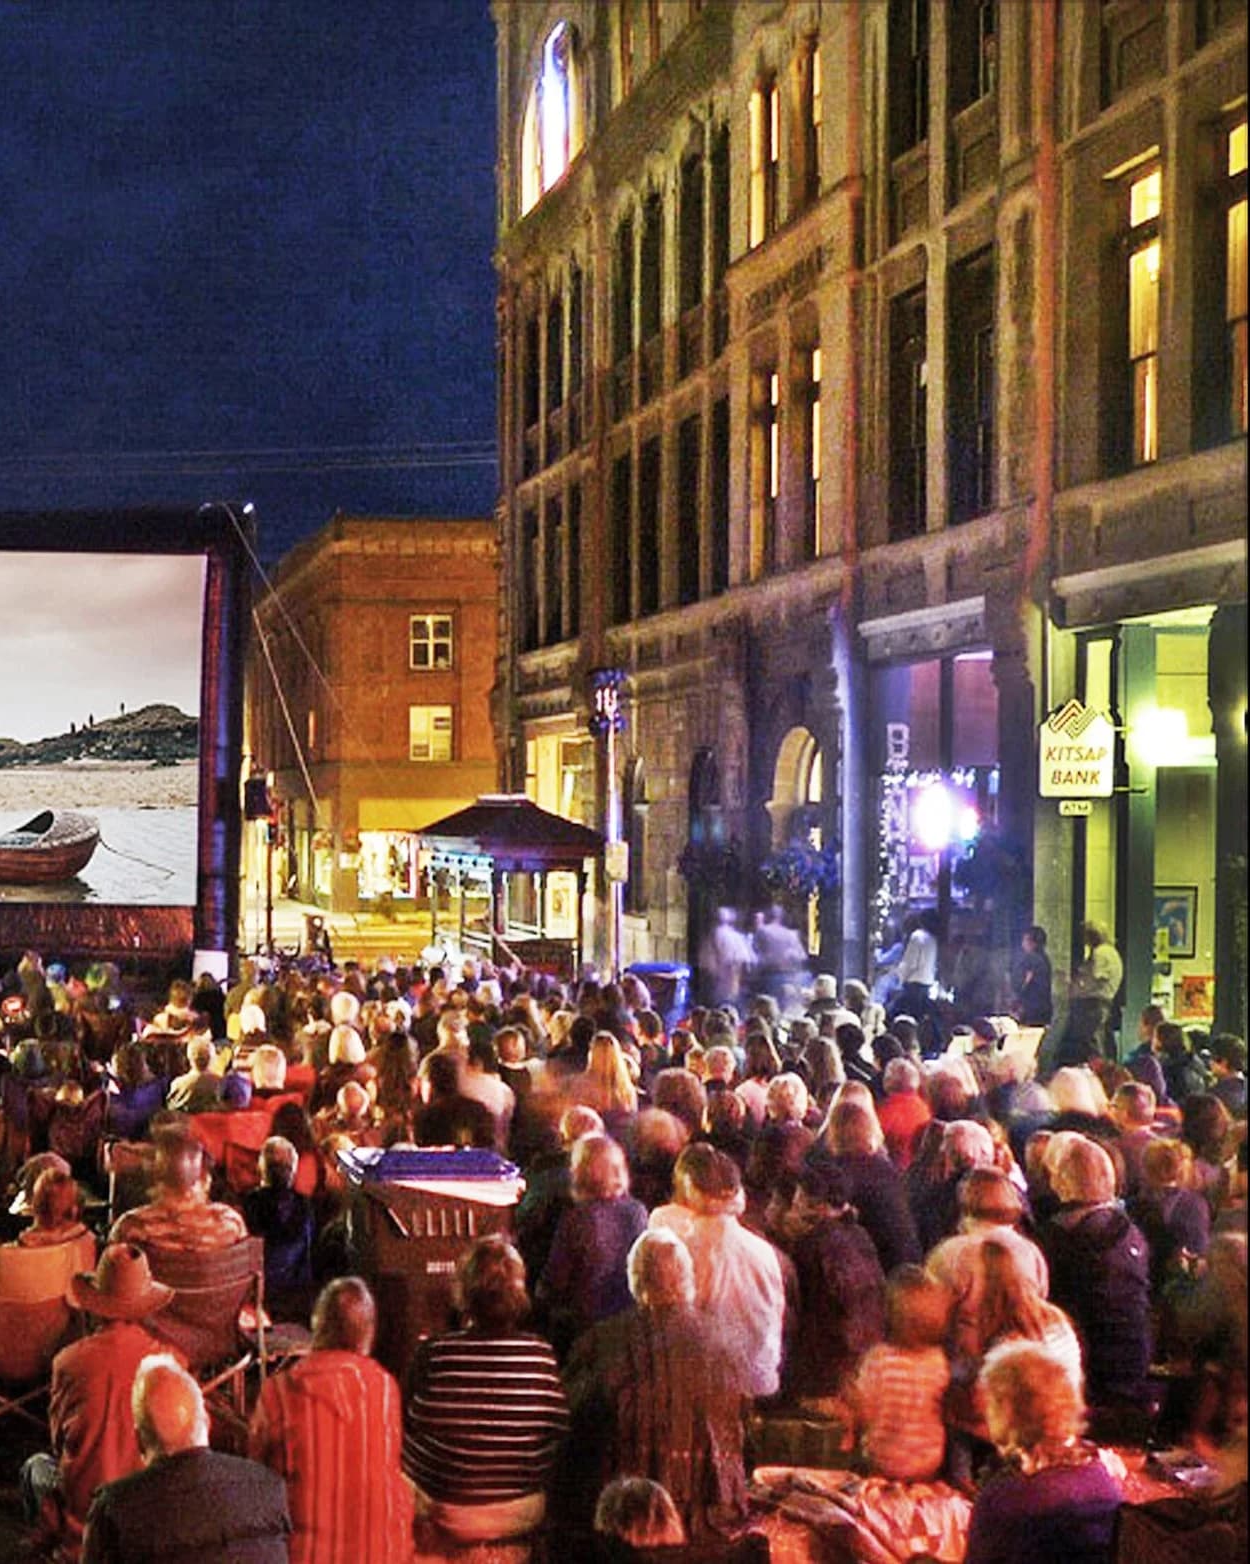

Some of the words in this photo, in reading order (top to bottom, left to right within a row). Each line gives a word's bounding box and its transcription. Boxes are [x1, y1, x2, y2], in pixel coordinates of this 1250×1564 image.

[1045, 746, 1107, 761] KITSAP
[1052, 770, 1100, 785] BANK
[1063, 803, 1089, 811] ATM
